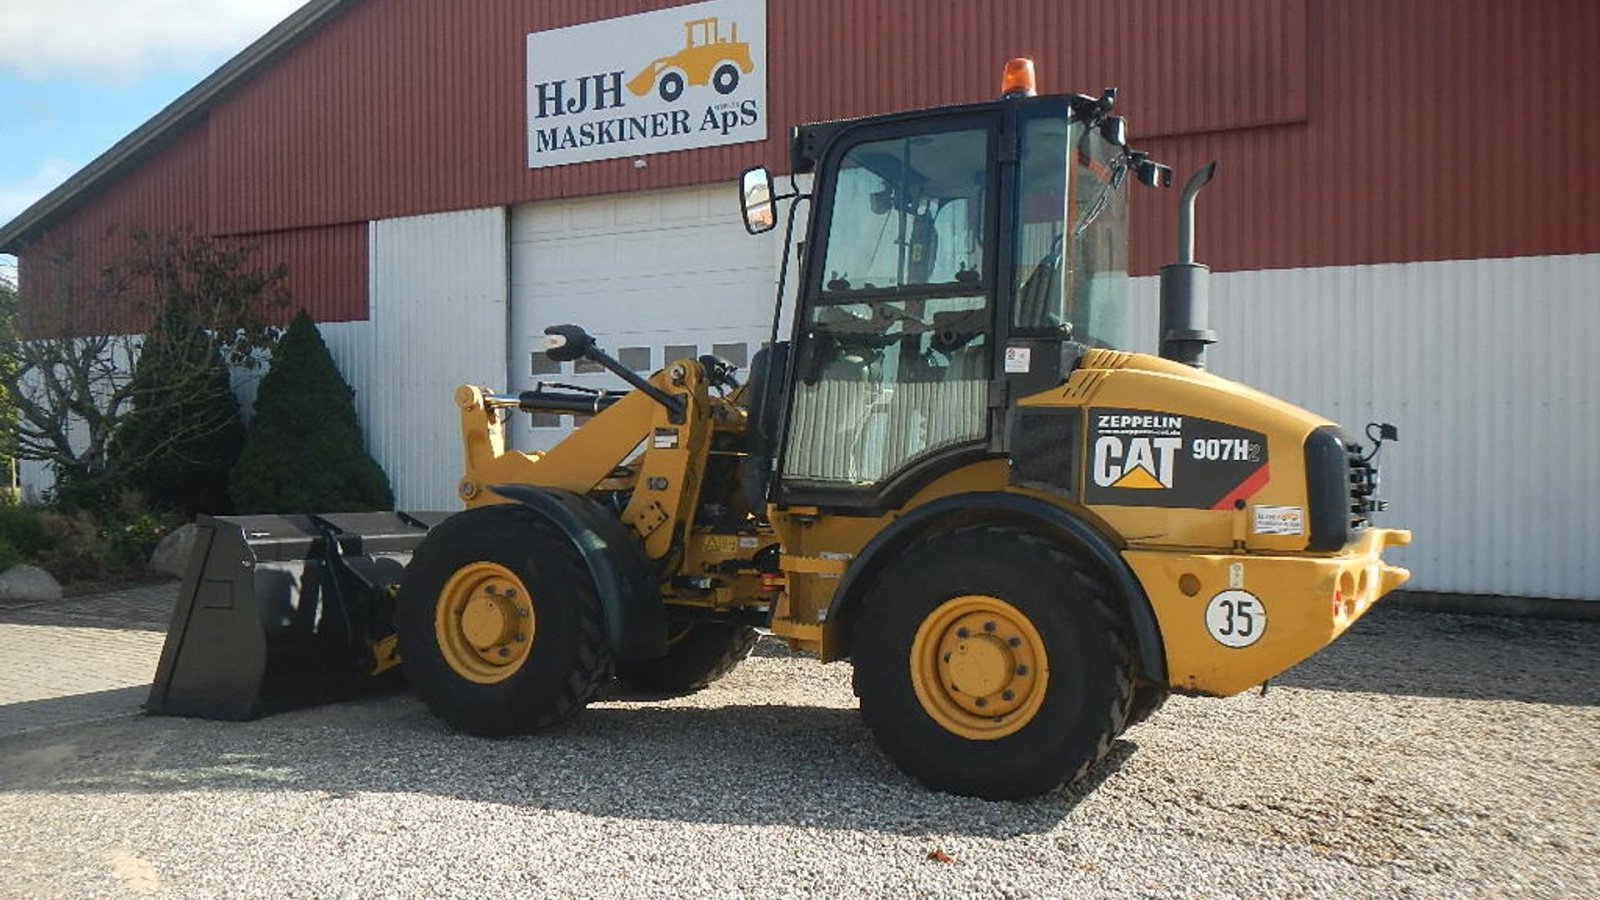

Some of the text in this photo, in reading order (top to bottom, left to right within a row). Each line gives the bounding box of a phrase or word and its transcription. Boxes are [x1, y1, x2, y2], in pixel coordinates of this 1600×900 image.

[534, 70, 626, 119] HJH
[536, 99, 758, 153] MASKINER ApS
[1098, 415, 1182, 428] ZEPPELIN
[1094, 436, 1183, 489] CAT
[1218, 600, 1253, 637] 35
